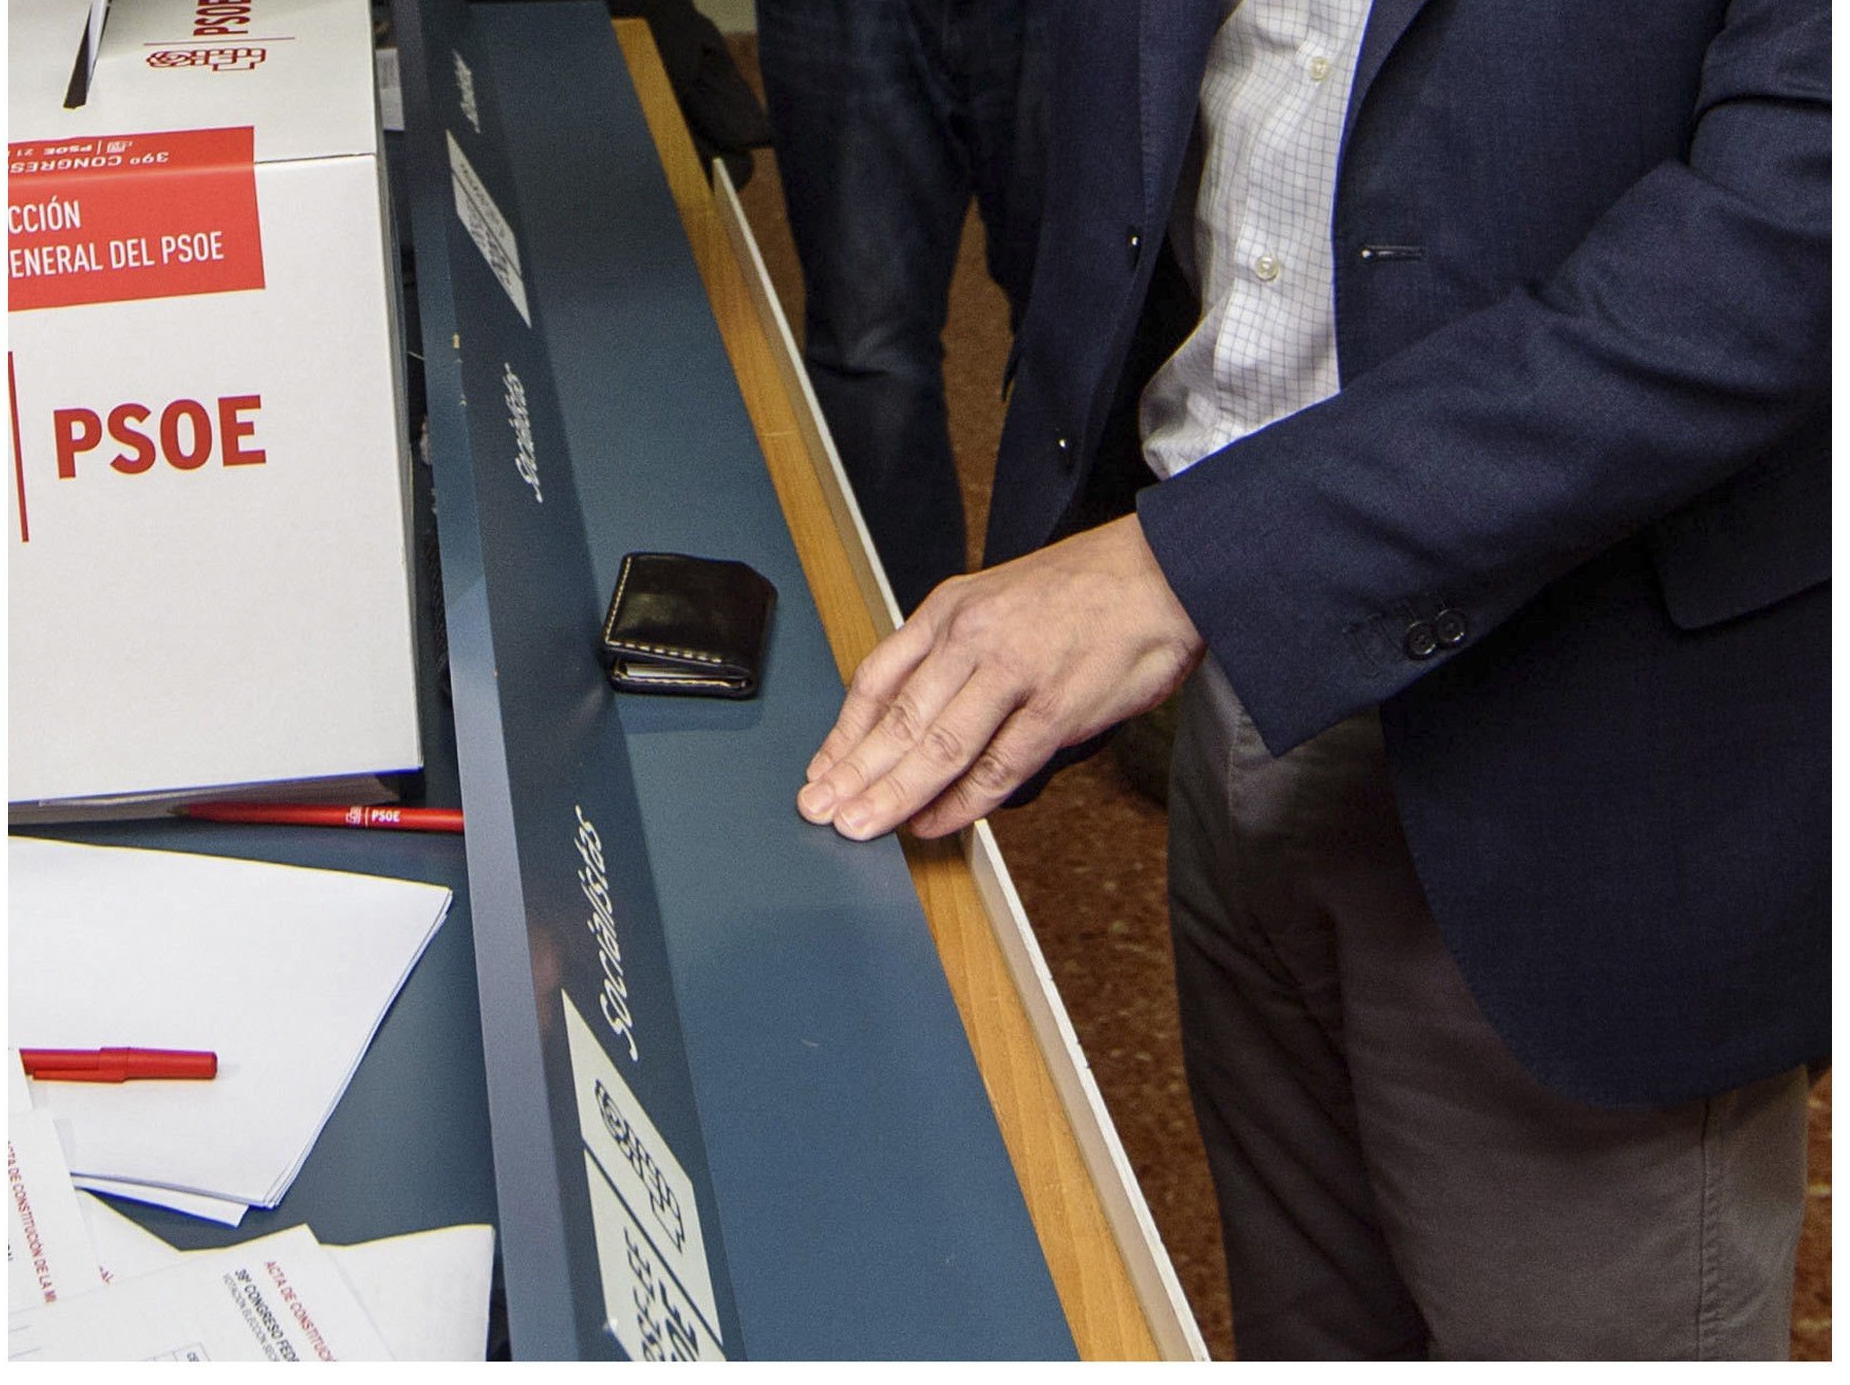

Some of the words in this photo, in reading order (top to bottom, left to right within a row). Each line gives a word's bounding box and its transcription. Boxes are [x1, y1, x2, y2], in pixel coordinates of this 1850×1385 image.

[9, 155, 122, 174] CONGRES
[43, 144, 92, 156] PSOE
[8, 195, 81, 234] CCIÓN
[109, 238, 155, 269] DEL
[161, 231, 224, 264] PSOE
[52, 394, 268, 482] PSOE
[371, 810, 401, 823] PSOE
[574, 805, 638, 1062] Socialistas
